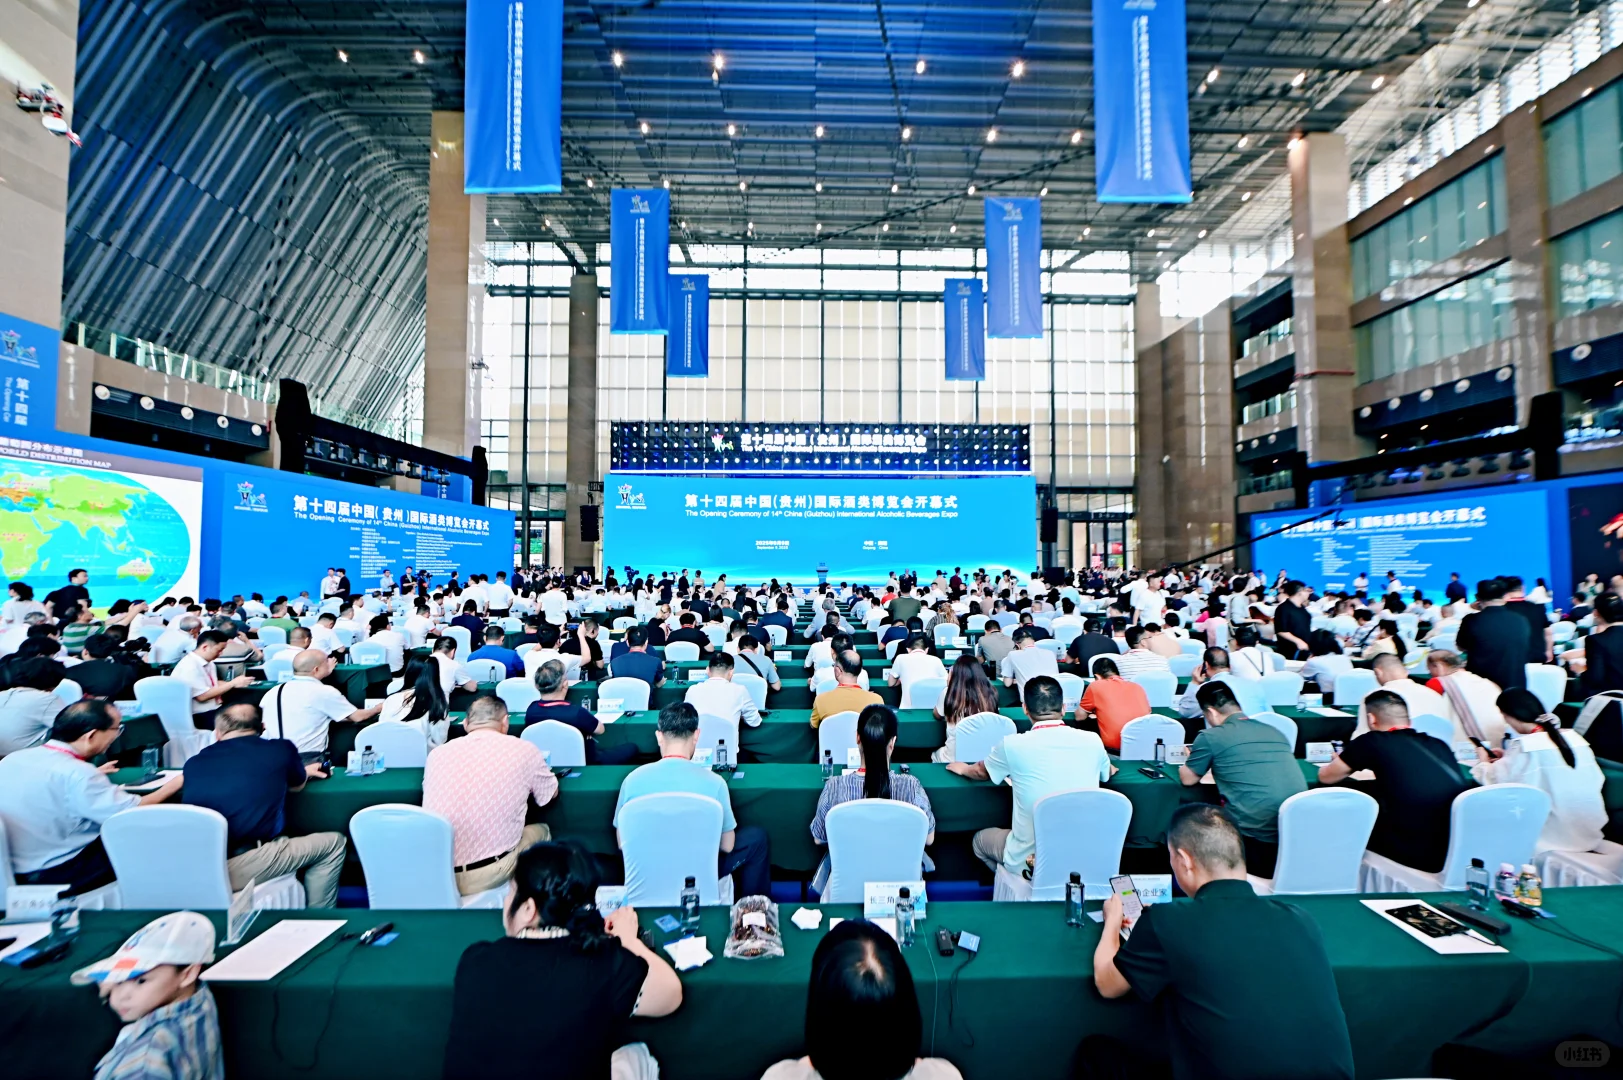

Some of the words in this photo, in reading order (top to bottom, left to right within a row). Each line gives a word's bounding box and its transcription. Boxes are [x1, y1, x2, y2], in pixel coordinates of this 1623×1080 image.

[294, 511, 307, 519] The
[309, 513, 335, 523] Opening
[338, 516, 365, 526] Ceremony
[700, 510, 727, 518] Opening
[729, 510, 761, 518] Ceremony
[906, 511, 940, 519] Beverages
[942, 511, 958, 519] Expo
[870, 895, 922, 905] 长三角家
